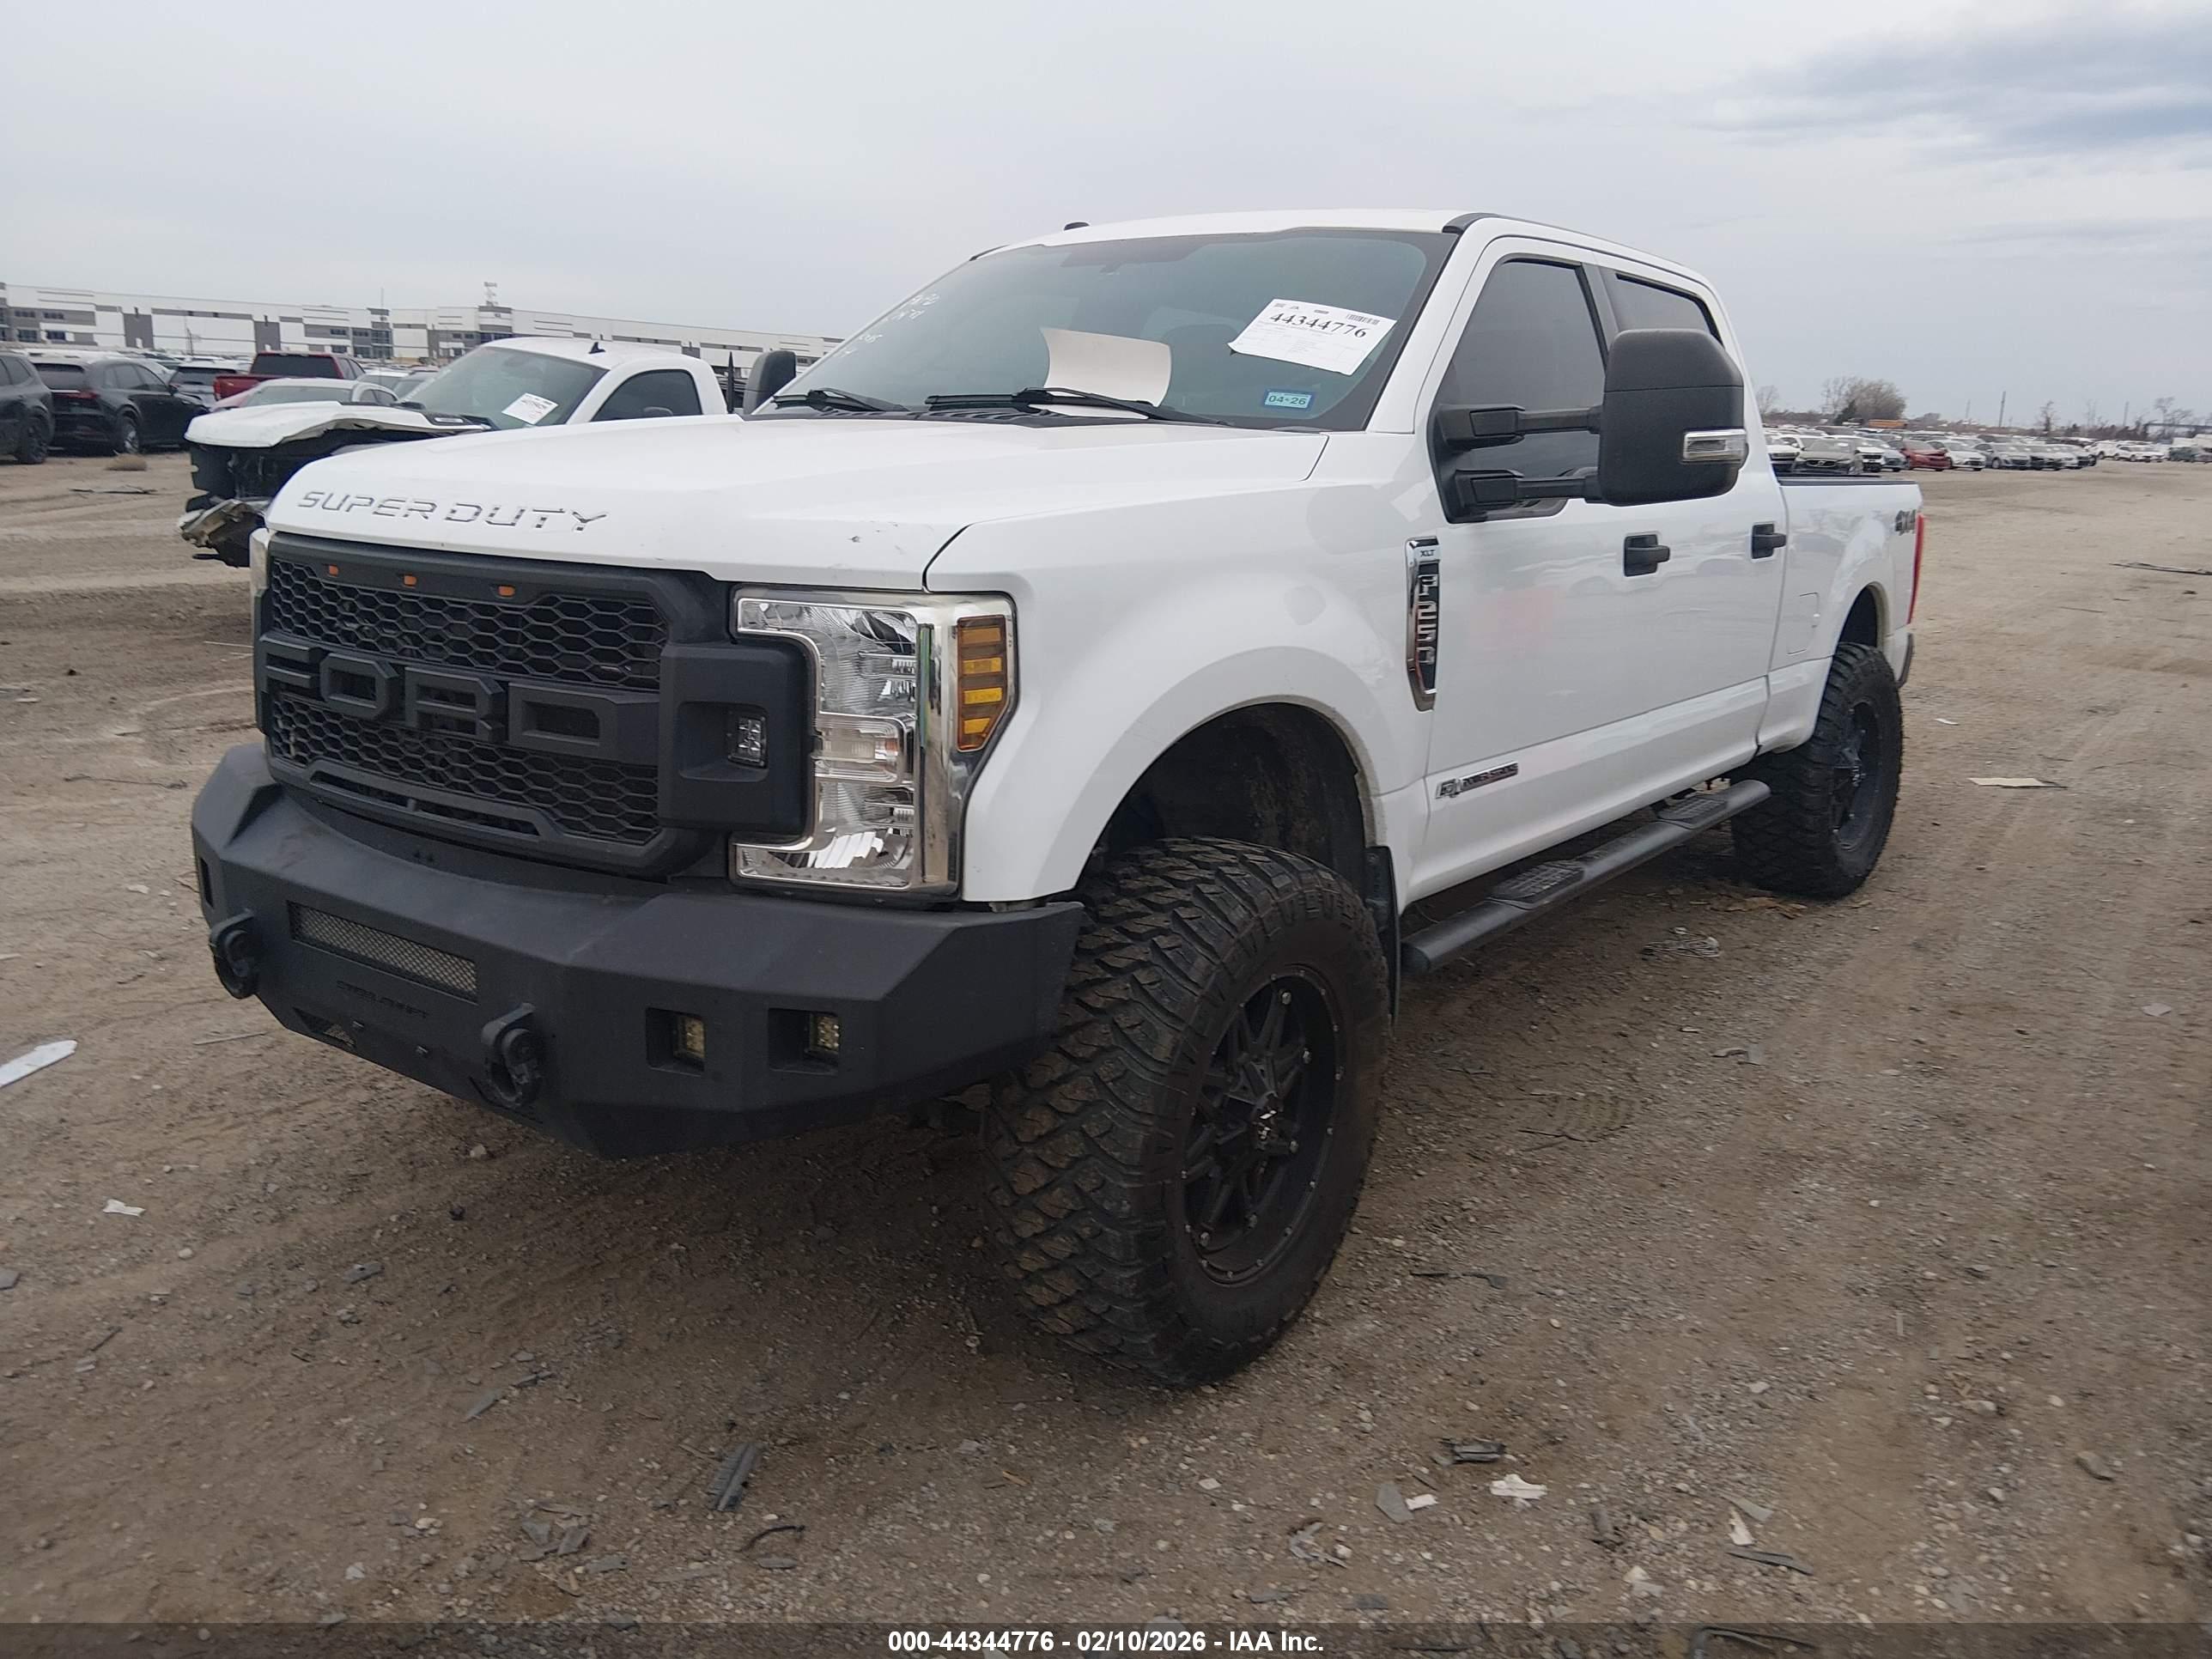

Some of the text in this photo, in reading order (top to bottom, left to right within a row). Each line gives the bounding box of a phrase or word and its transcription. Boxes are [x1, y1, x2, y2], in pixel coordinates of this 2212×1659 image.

[1269, 312, 1370, 338] 44344776
[297, 491, 608, 532] SUPER DUTY
[258, 632, 623, 761] FORD
